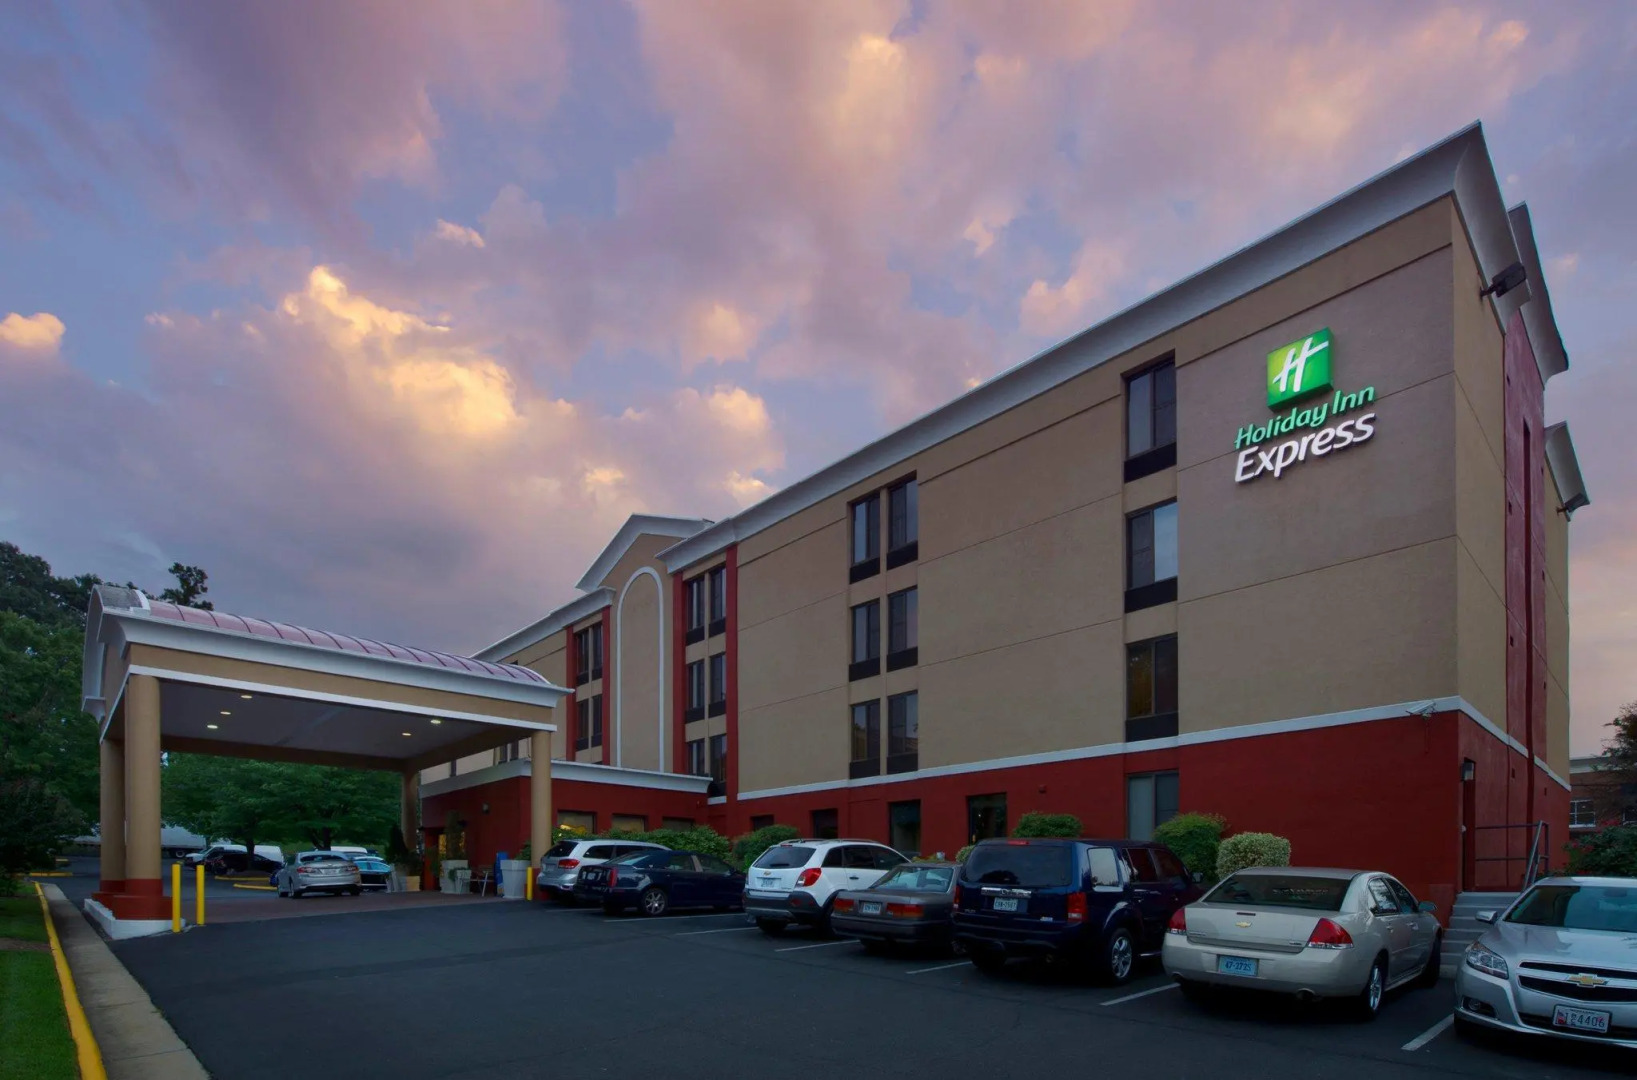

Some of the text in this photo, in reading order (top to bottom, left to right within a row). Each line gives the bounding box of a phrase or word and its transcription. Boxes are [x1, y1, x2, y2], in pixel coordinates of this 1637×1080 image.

[1273, 337, 1329, 392] H
[1234, 386, 1375, 449] Holiday Inn
[1235, 412, 1376, 482] Express
